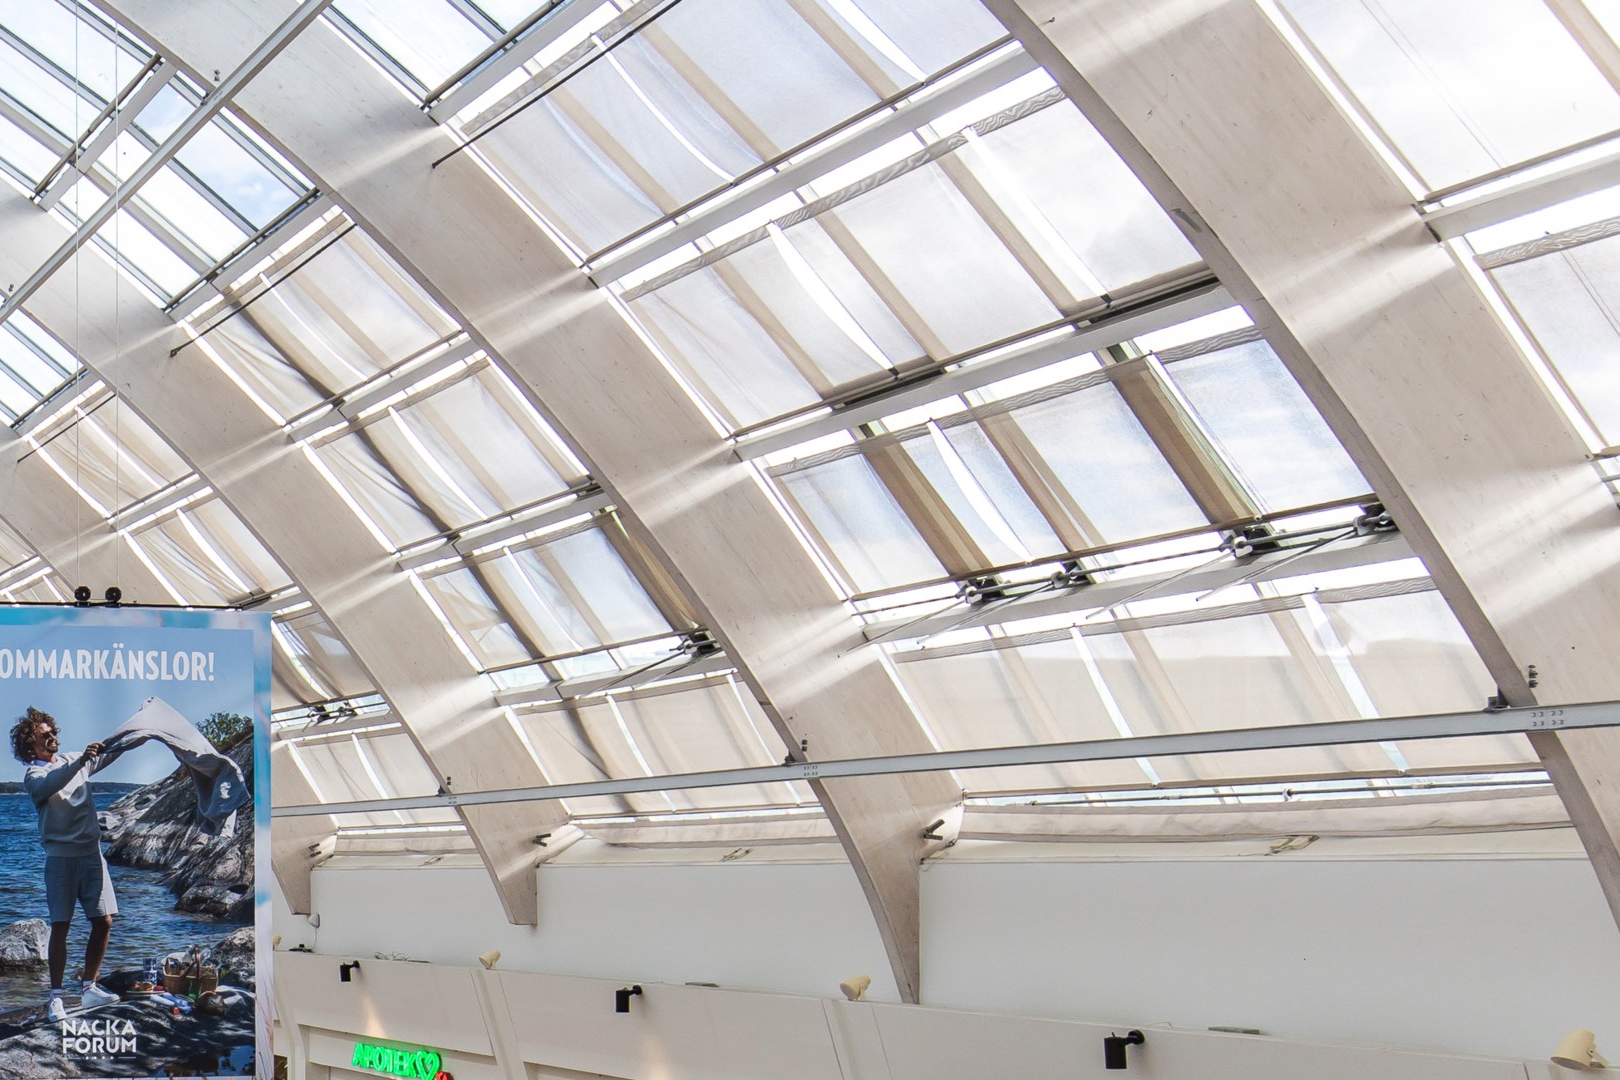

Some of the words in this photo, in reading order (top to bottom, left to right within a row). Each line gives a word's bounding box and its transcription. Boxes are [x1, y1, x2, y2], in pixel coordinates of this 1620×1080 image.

[62, 1019, 137, 1036] NACKA
[62, 1037, 137, 1054] FORUM
[352, 1042, 417, 1079] APOTEK
